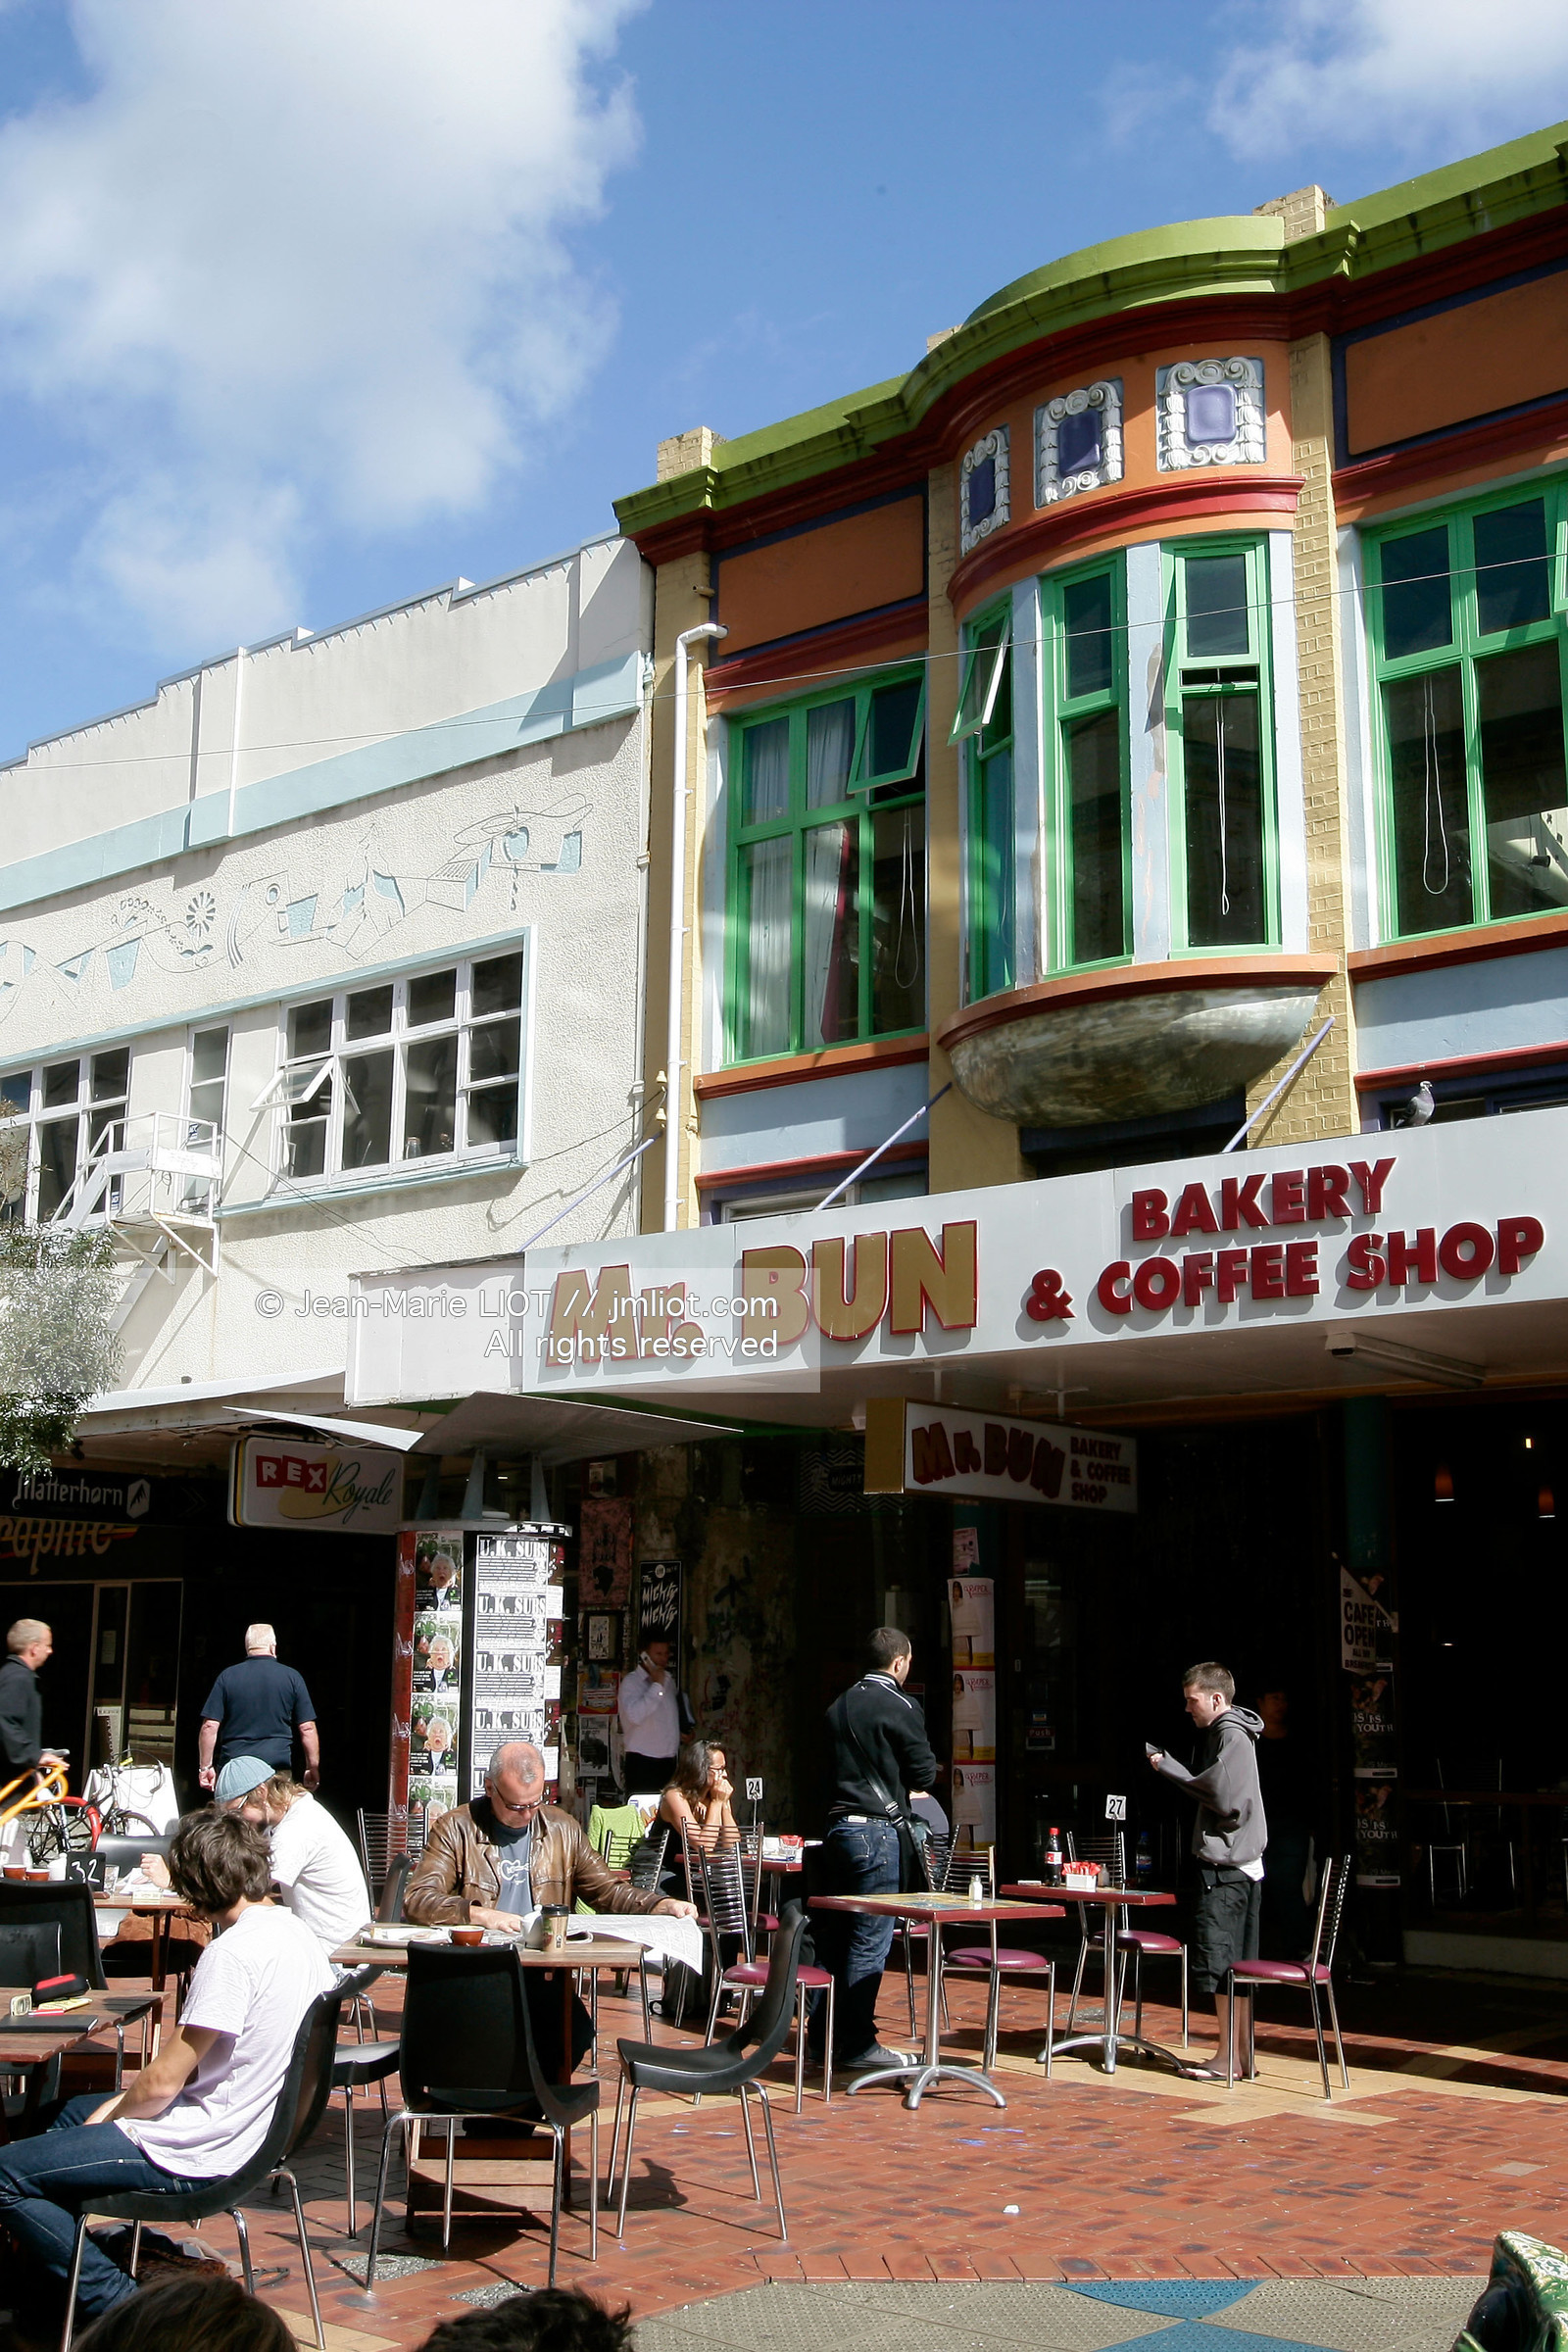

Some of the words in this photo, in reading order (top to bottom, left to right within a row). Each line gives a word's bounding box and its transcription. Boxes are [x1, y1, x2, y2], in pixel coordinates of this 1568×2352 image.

[1132, 1156, 1397, 1242] BAKERY
[1026, 1268, 1076, 1322] &
[1097, 1241, 1320, 1315] COFFEE
[1347, 1215, 1544, 1292] SHOP
[545, 1263, 706, 1367] Mr.
[742, 1219, 978, 1347] BUN
[1070, 1436, 1121, 1461] BAKERY
[911, 1422, 981, 1485] Mr.
[984, 1423, 1066, 1499] BUN
[1087, 1461, 1131, 1485] COFFEE
[262, 1460, 324, 1490] REX
[323, 1461, 396, 1525] Royale
[1071, 1482, 1107, 1503] SHOP
[515, 1541, 548, 1559] SUBS
[514, 1596, 546, 1616] SUBS
[1344, 1601, 1376, 1627] CAFE
[1344, 1624, 1375, 1647] OPEN
[513, 1654, 545, 1673] SUBS
[512, 1712, 544, 1730] SUBS
[1356, 1724, 1394, 1733] YOUTH
[748, 1781, 760, 1795] 24
[1108, 1798, 1123, 1815] 27
[1359, 1830, 1397, 1839] YOUTH
[70, 1858, 100, 1884] 32
